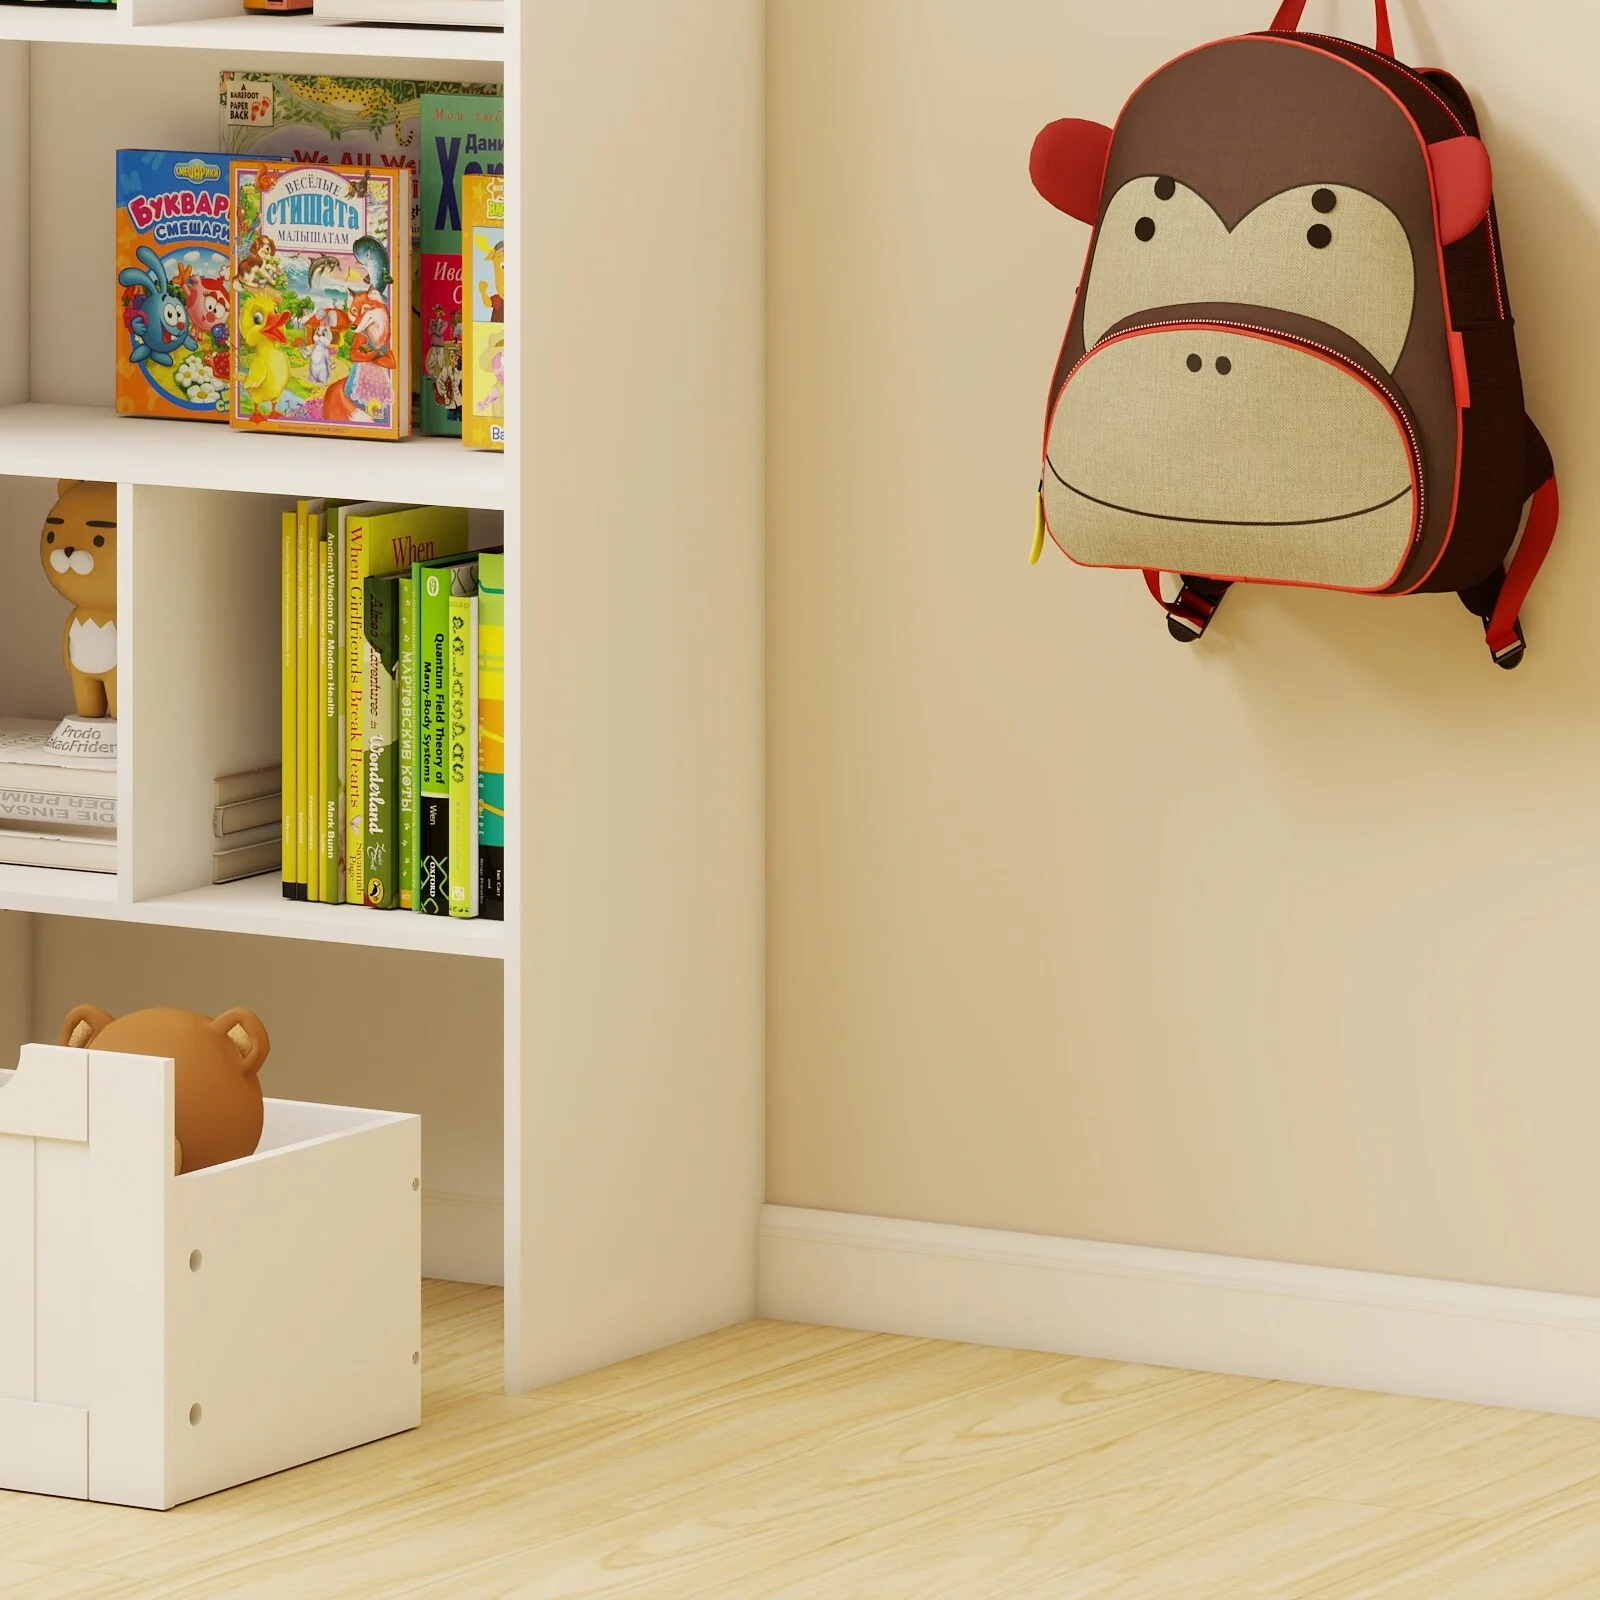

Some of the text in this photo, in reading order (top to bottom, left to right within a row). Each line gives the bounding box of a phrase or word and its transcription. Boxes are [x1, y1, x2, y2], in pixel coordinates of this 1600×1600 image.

[230, 102, 249, 110] PAPER
[230, 110, 249, 120] BACK
[285, 173, 341, 196] ВЕСЁЛЫЕ
[130, 191, 229, 227] БУКВАР
[277, 230, 350, 244] МАЛЫШАТАМ
[392, 536, 434, 568] When
[327, 532, 335, 717] Ancient Wisdom for Modern Health
[350, 527, 363, 808] When Girlfriends Break Hearts
[422, 661, 431, 783] Many-Body Systems
[434, 633, 444, 785] Quantum Field Theory of
[368, 734, 385, 834] Wonderland
[69, 796, 115, 811] DER
[78, 810, 115, 823] DIE
[429, 805, 437, 825] Wen
